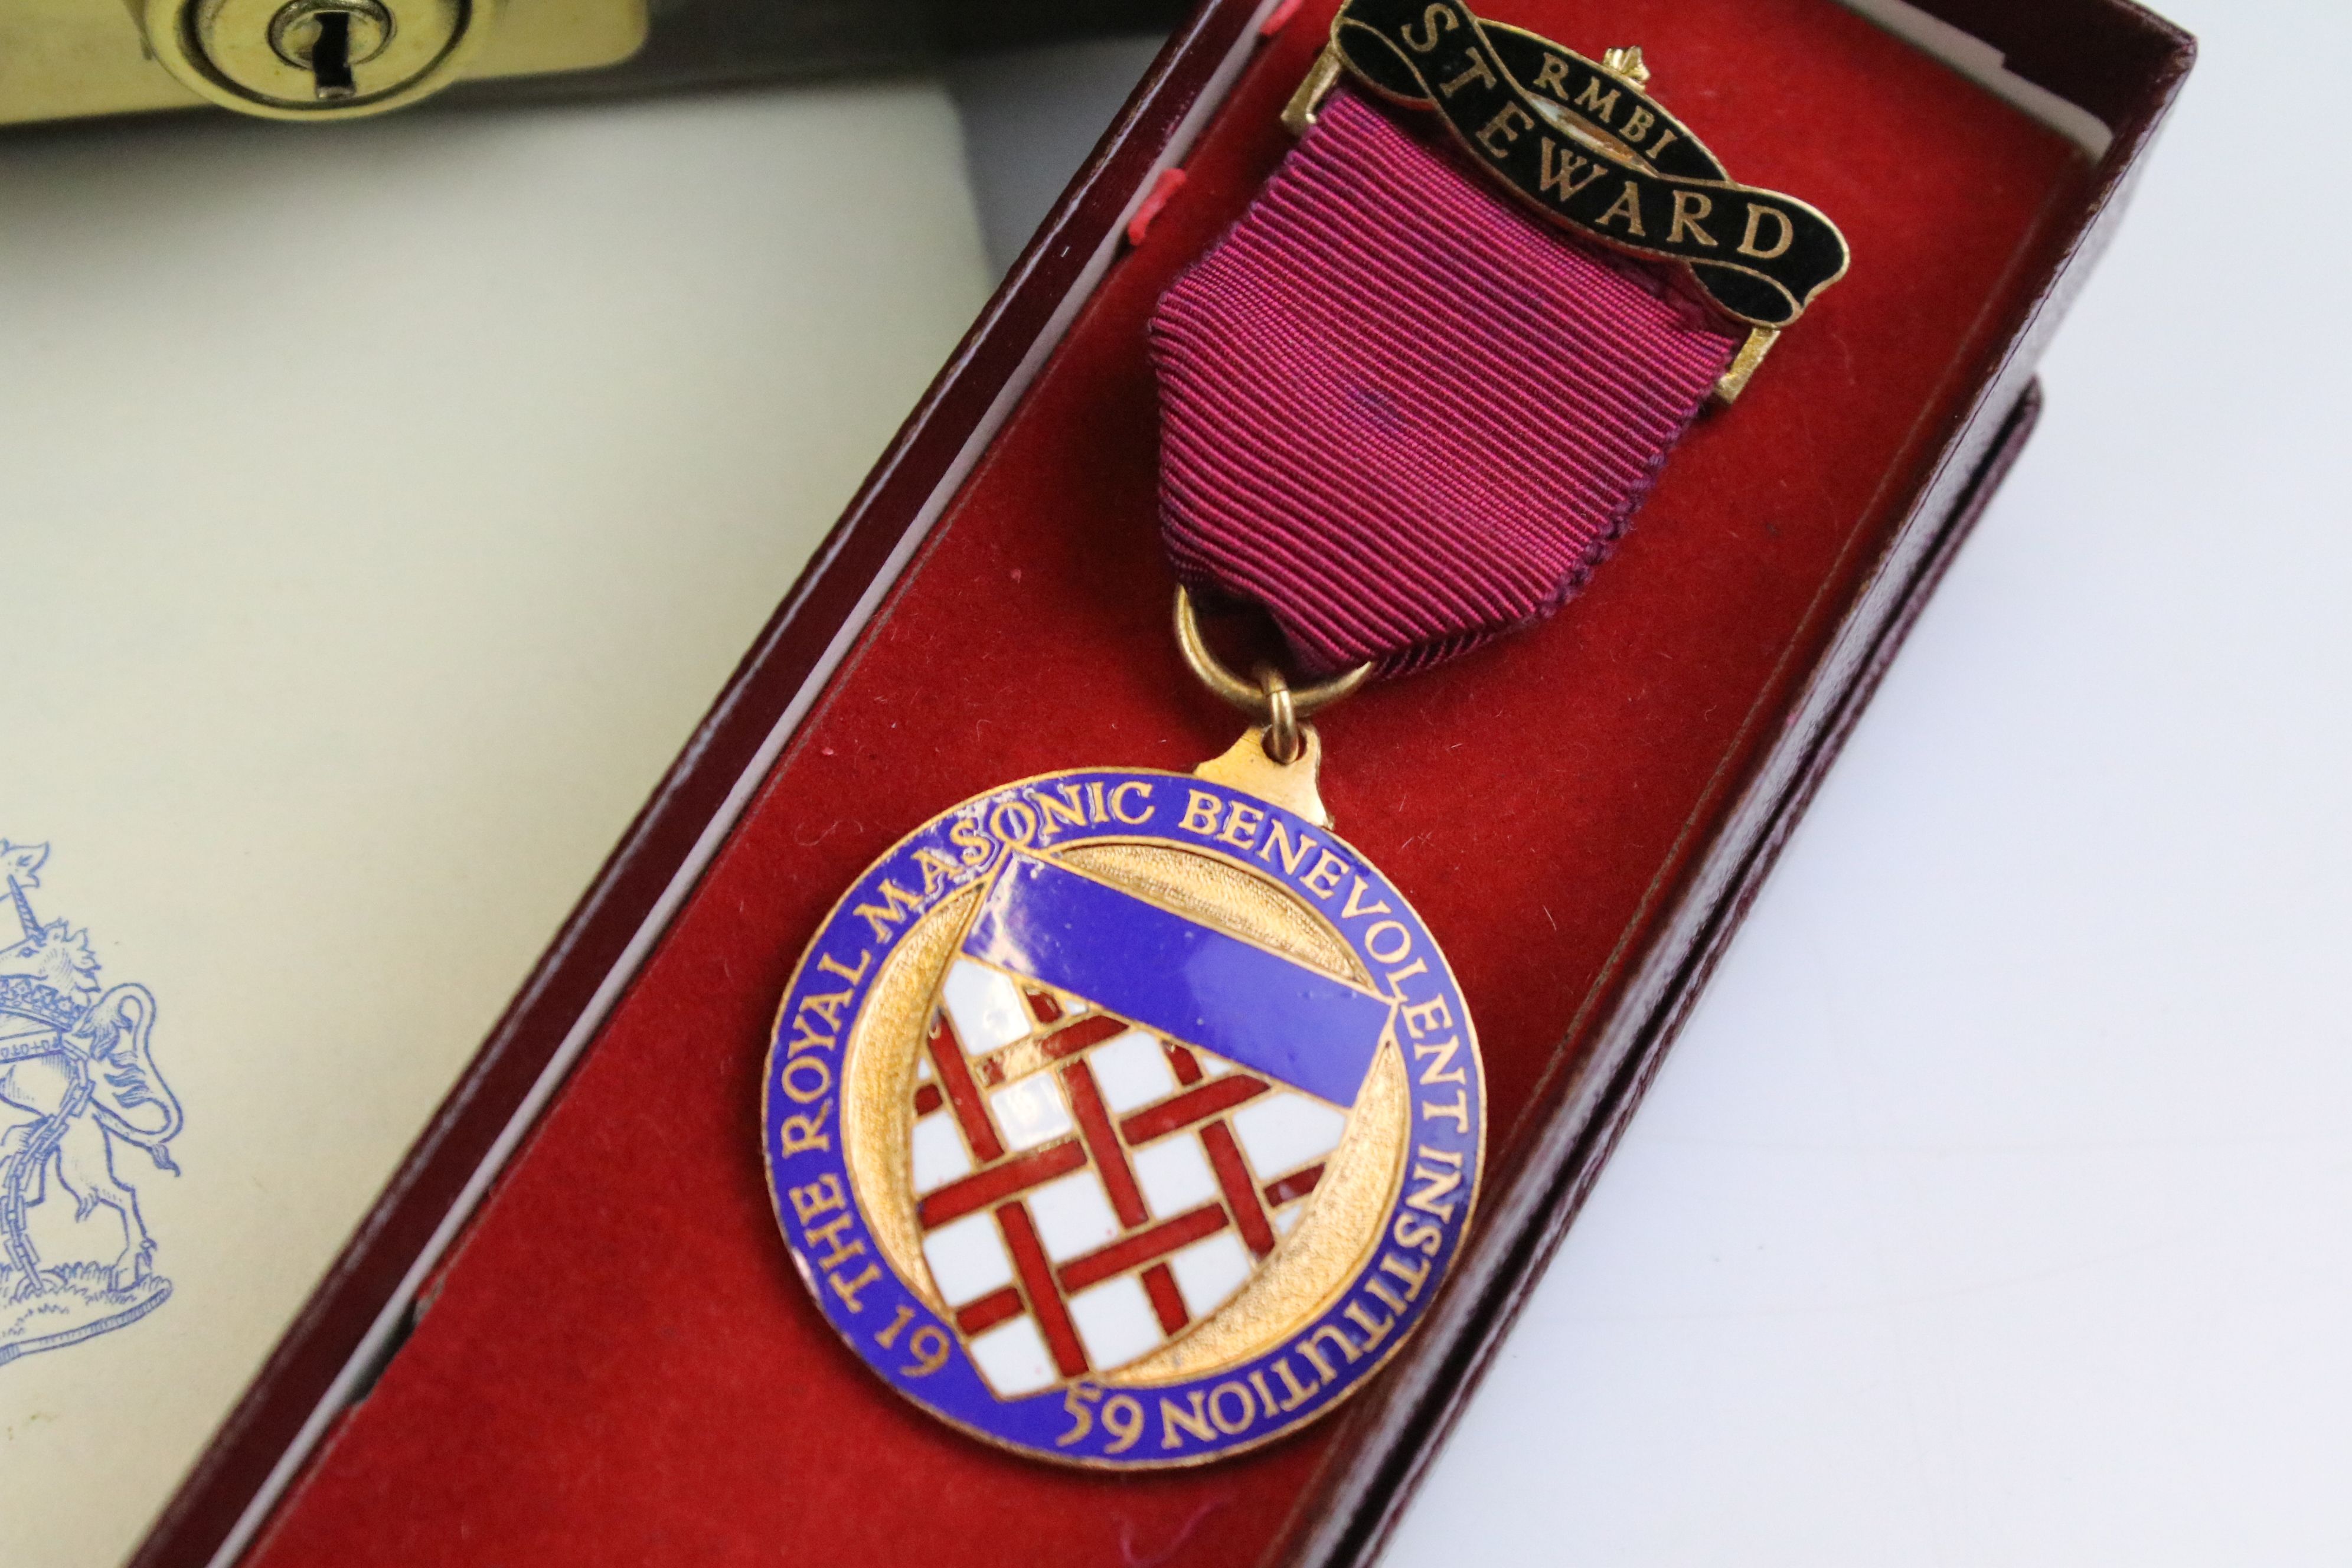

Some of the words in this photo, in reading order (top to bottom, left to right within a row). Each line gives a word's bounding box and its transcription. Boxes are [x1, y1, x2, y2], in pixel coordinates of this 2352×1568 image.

[1401, 2, 1793, 259] STEWARD
[1533, 53, 1678, 160] RMBI
[853, 781, 1155, 943] MASONIC
[1178, 789, 1469, 1134] BENEVOLENT
[781, 949, 871, 1158] ROYAL
[789, 1172, 881, 1313] THE
[1160, 1145, 1463, 1449] INSTITUTION
